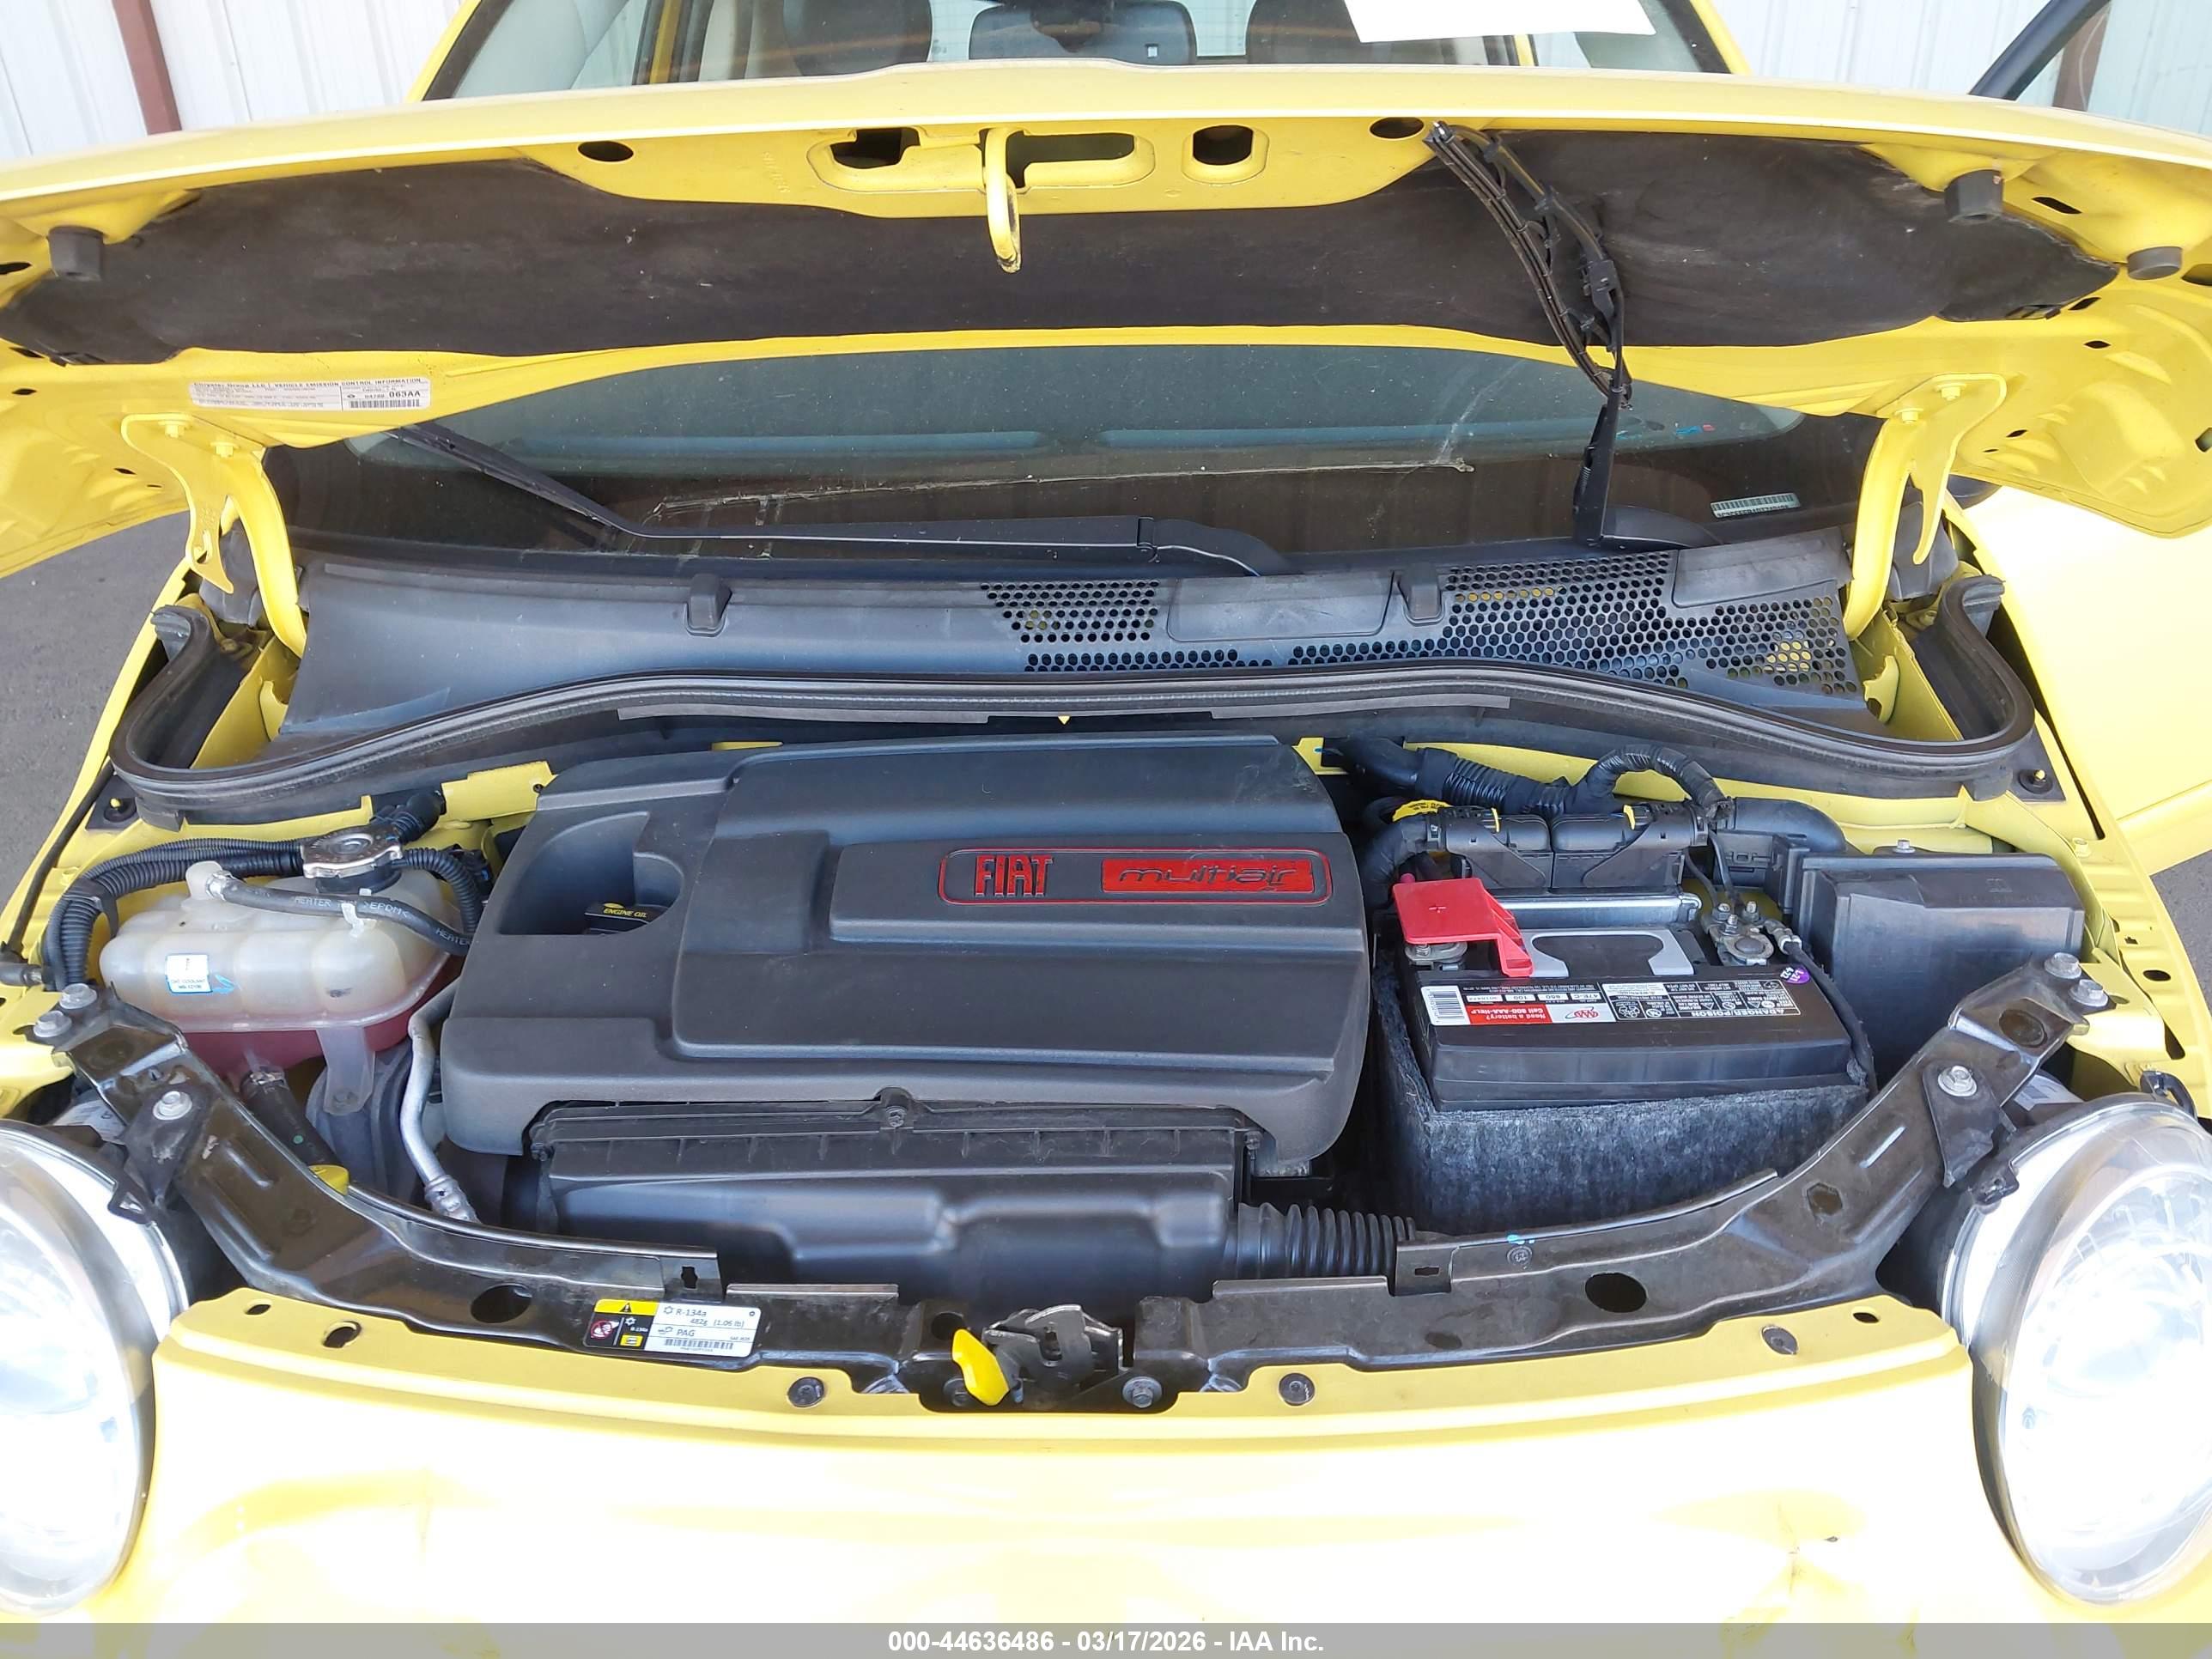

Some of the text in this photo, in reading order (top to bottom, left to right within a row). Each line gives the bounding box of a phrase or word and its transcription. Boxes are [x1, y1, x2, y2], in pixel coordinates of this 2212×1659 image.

[974, 855, 1054, 897] FIAT
[1119, 864, 1297, 886] multiair
[295, 896, 331, 908] HEATER
[603, 908, 634, 917] ENGINE
[1575, 1010, 1599, 1018] AAA
[675, 1308, 708, 1317] R-134a
[676, 1328, 696, 1337] PAG
